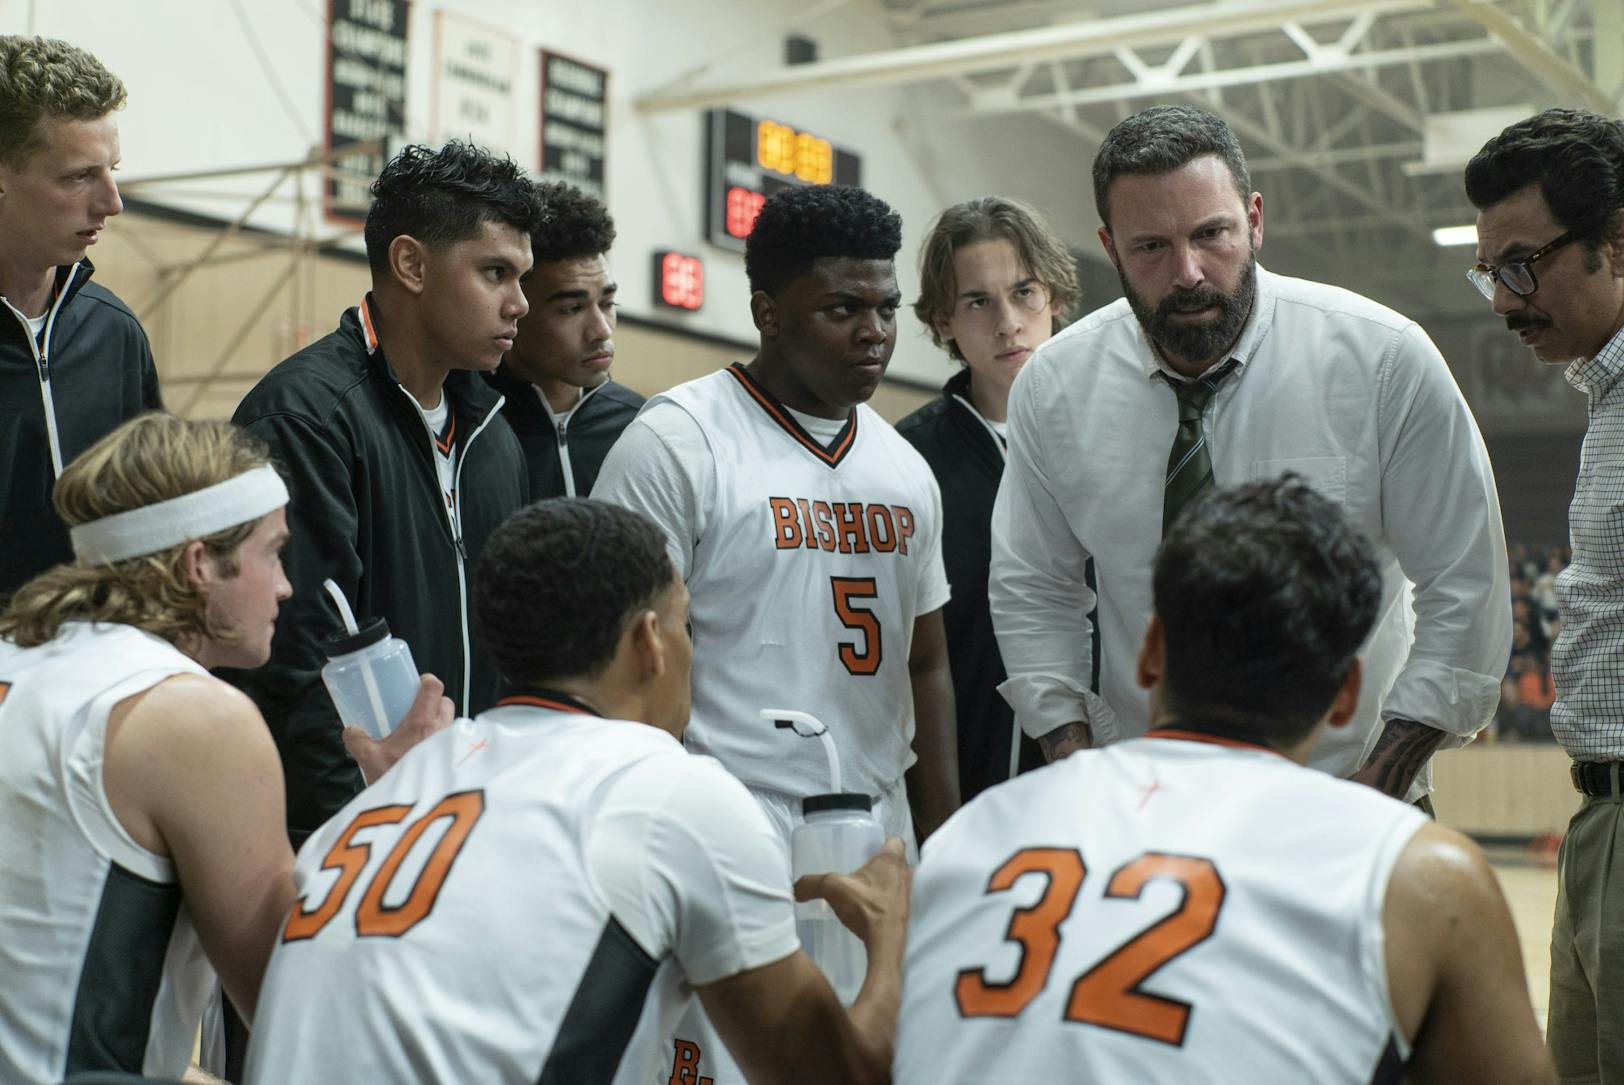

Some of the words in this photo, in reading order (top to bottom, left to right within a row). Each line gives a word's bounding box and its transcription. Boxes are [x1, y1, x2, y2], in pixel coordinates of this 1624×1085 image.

[769, 496, 915, 556] BISHOP
[830, 576, 883, 676] 5
[282, 788, 485, 945] 50
[954, 846, 1227, 1049] 32
